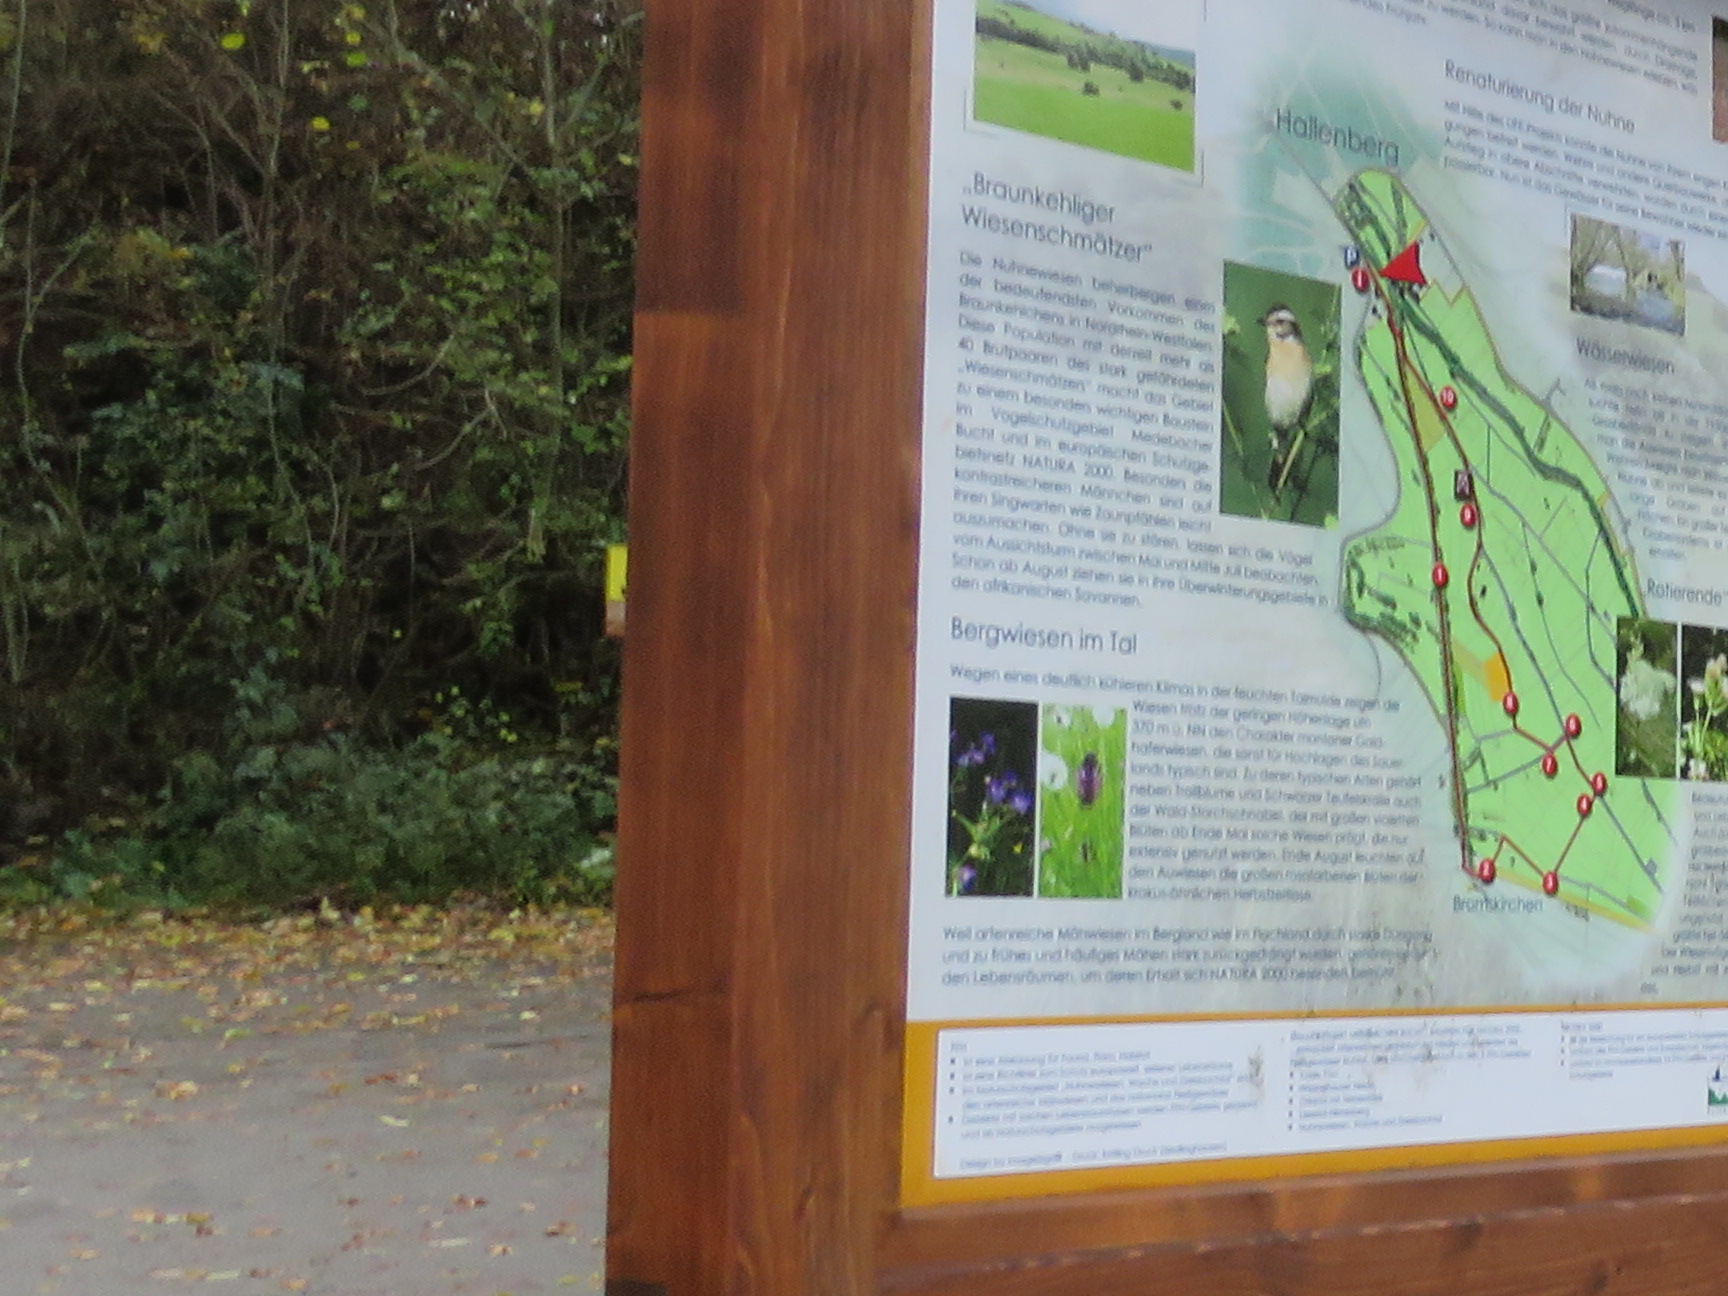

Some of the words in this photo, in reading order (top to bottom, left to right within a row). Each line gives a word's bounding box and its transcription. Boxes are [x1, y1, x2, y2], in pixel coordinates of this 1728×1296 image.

[1445, 60, 1554, 115] Renaturierung
[1558, 94, 1581, 118] der
[1587, 103, 1634, 134] Nuhne
[1273, 107, 1399, 170] Hallenberg
[951, 618, 1072, 649] Bergwiesen
[1079, 630, 1103, 651] im
[1111, 633, 1137, 654] Tal
